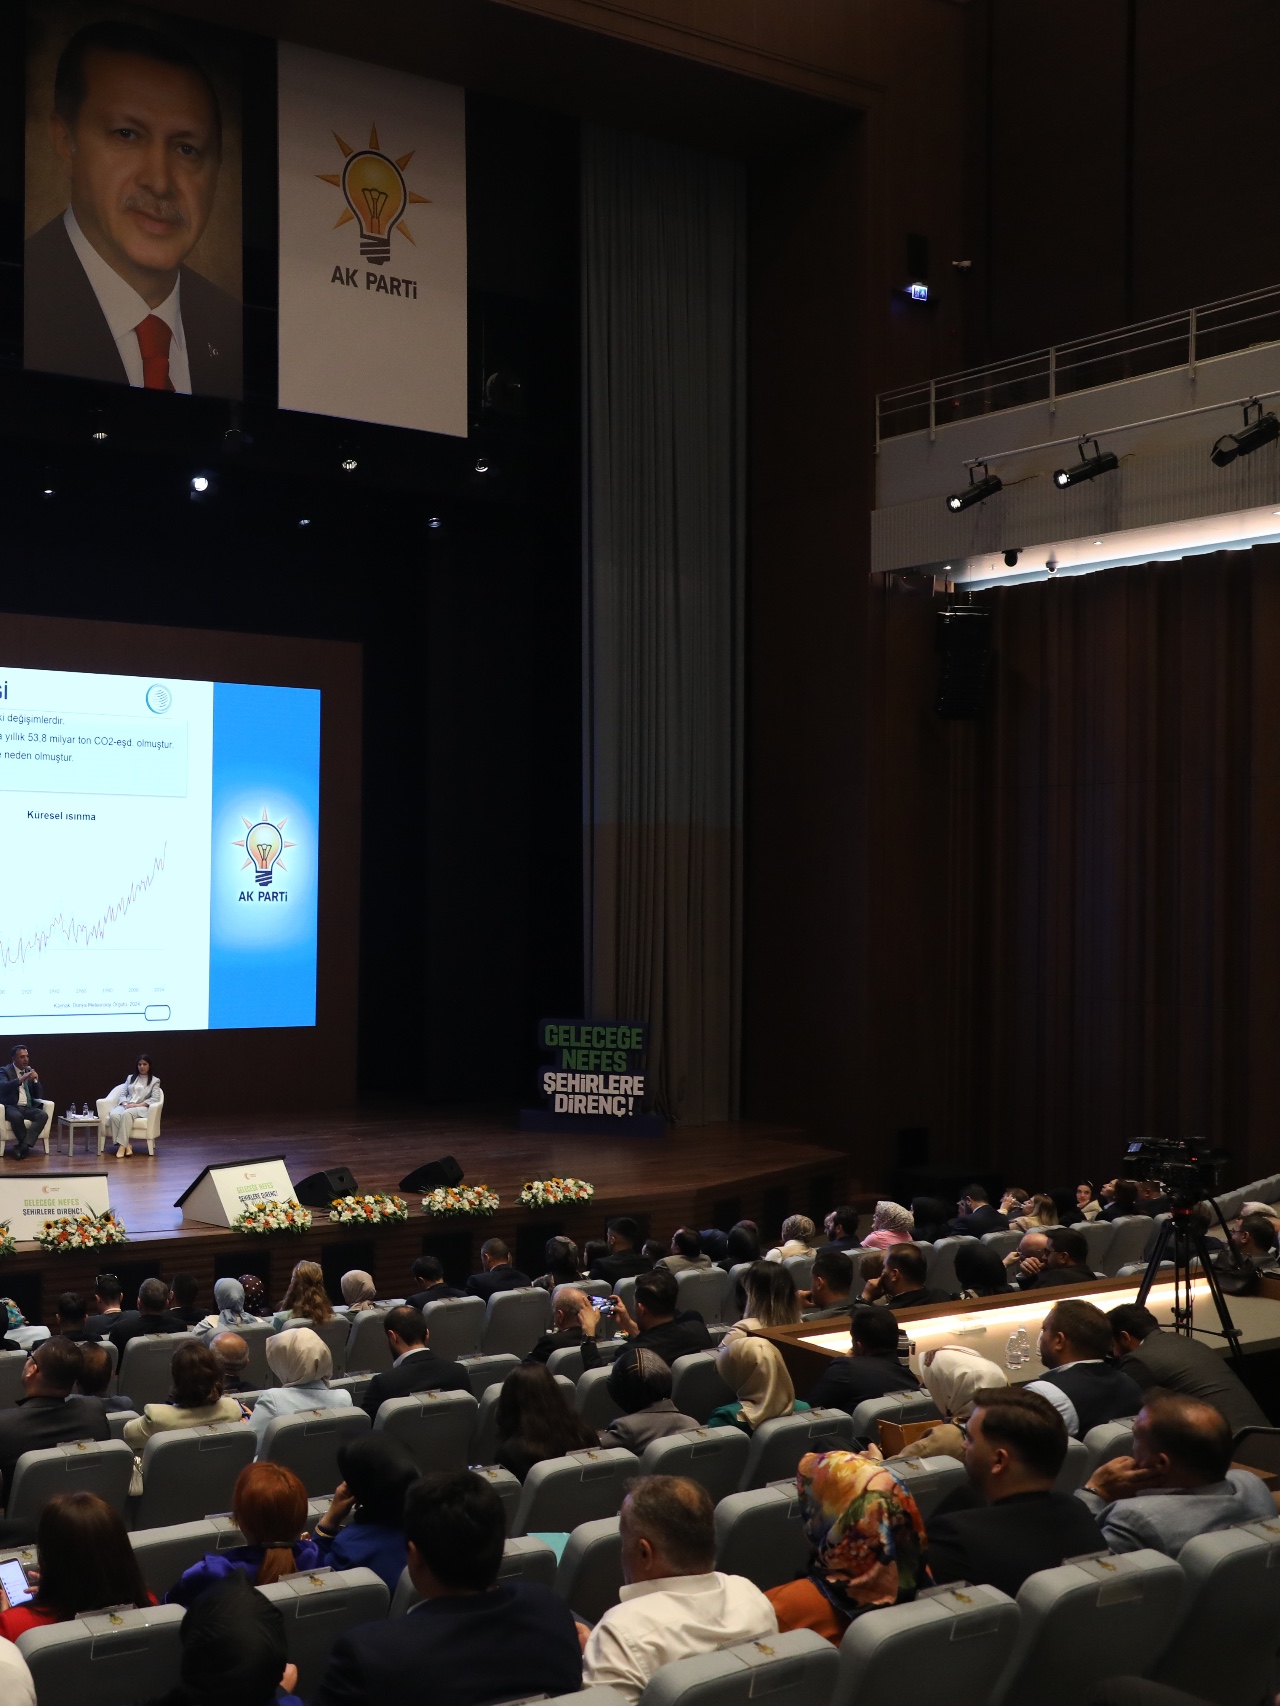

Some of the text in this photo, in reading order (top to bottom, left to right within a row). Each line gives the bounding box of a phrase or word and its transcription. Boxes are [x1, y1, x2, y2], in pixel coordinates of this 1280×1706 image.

[331, 266, 358, 288] AK
[7, 713, 64, 725] değişimlerdir.
[4, 732, 25, 742] yıllık
[27, 732, 47, 742] 53,8
[49, 734, 75, 745] milyar
[77, 735, 91, 744] ton
[93, 736, 133, 748] CO2-eşd.
[136, 739, 173, 750] olmuştur.
[4, 750, 31, 759] neden
[34, 751, 73, 763] olmuştur.
[27, 810, 96, 821] Küresel ısınma
[238, 891, 254, 902] AK
[544, 1024, 643, 1049] GELECEĞE
[562, 1048, 627, 1072] NEFES
